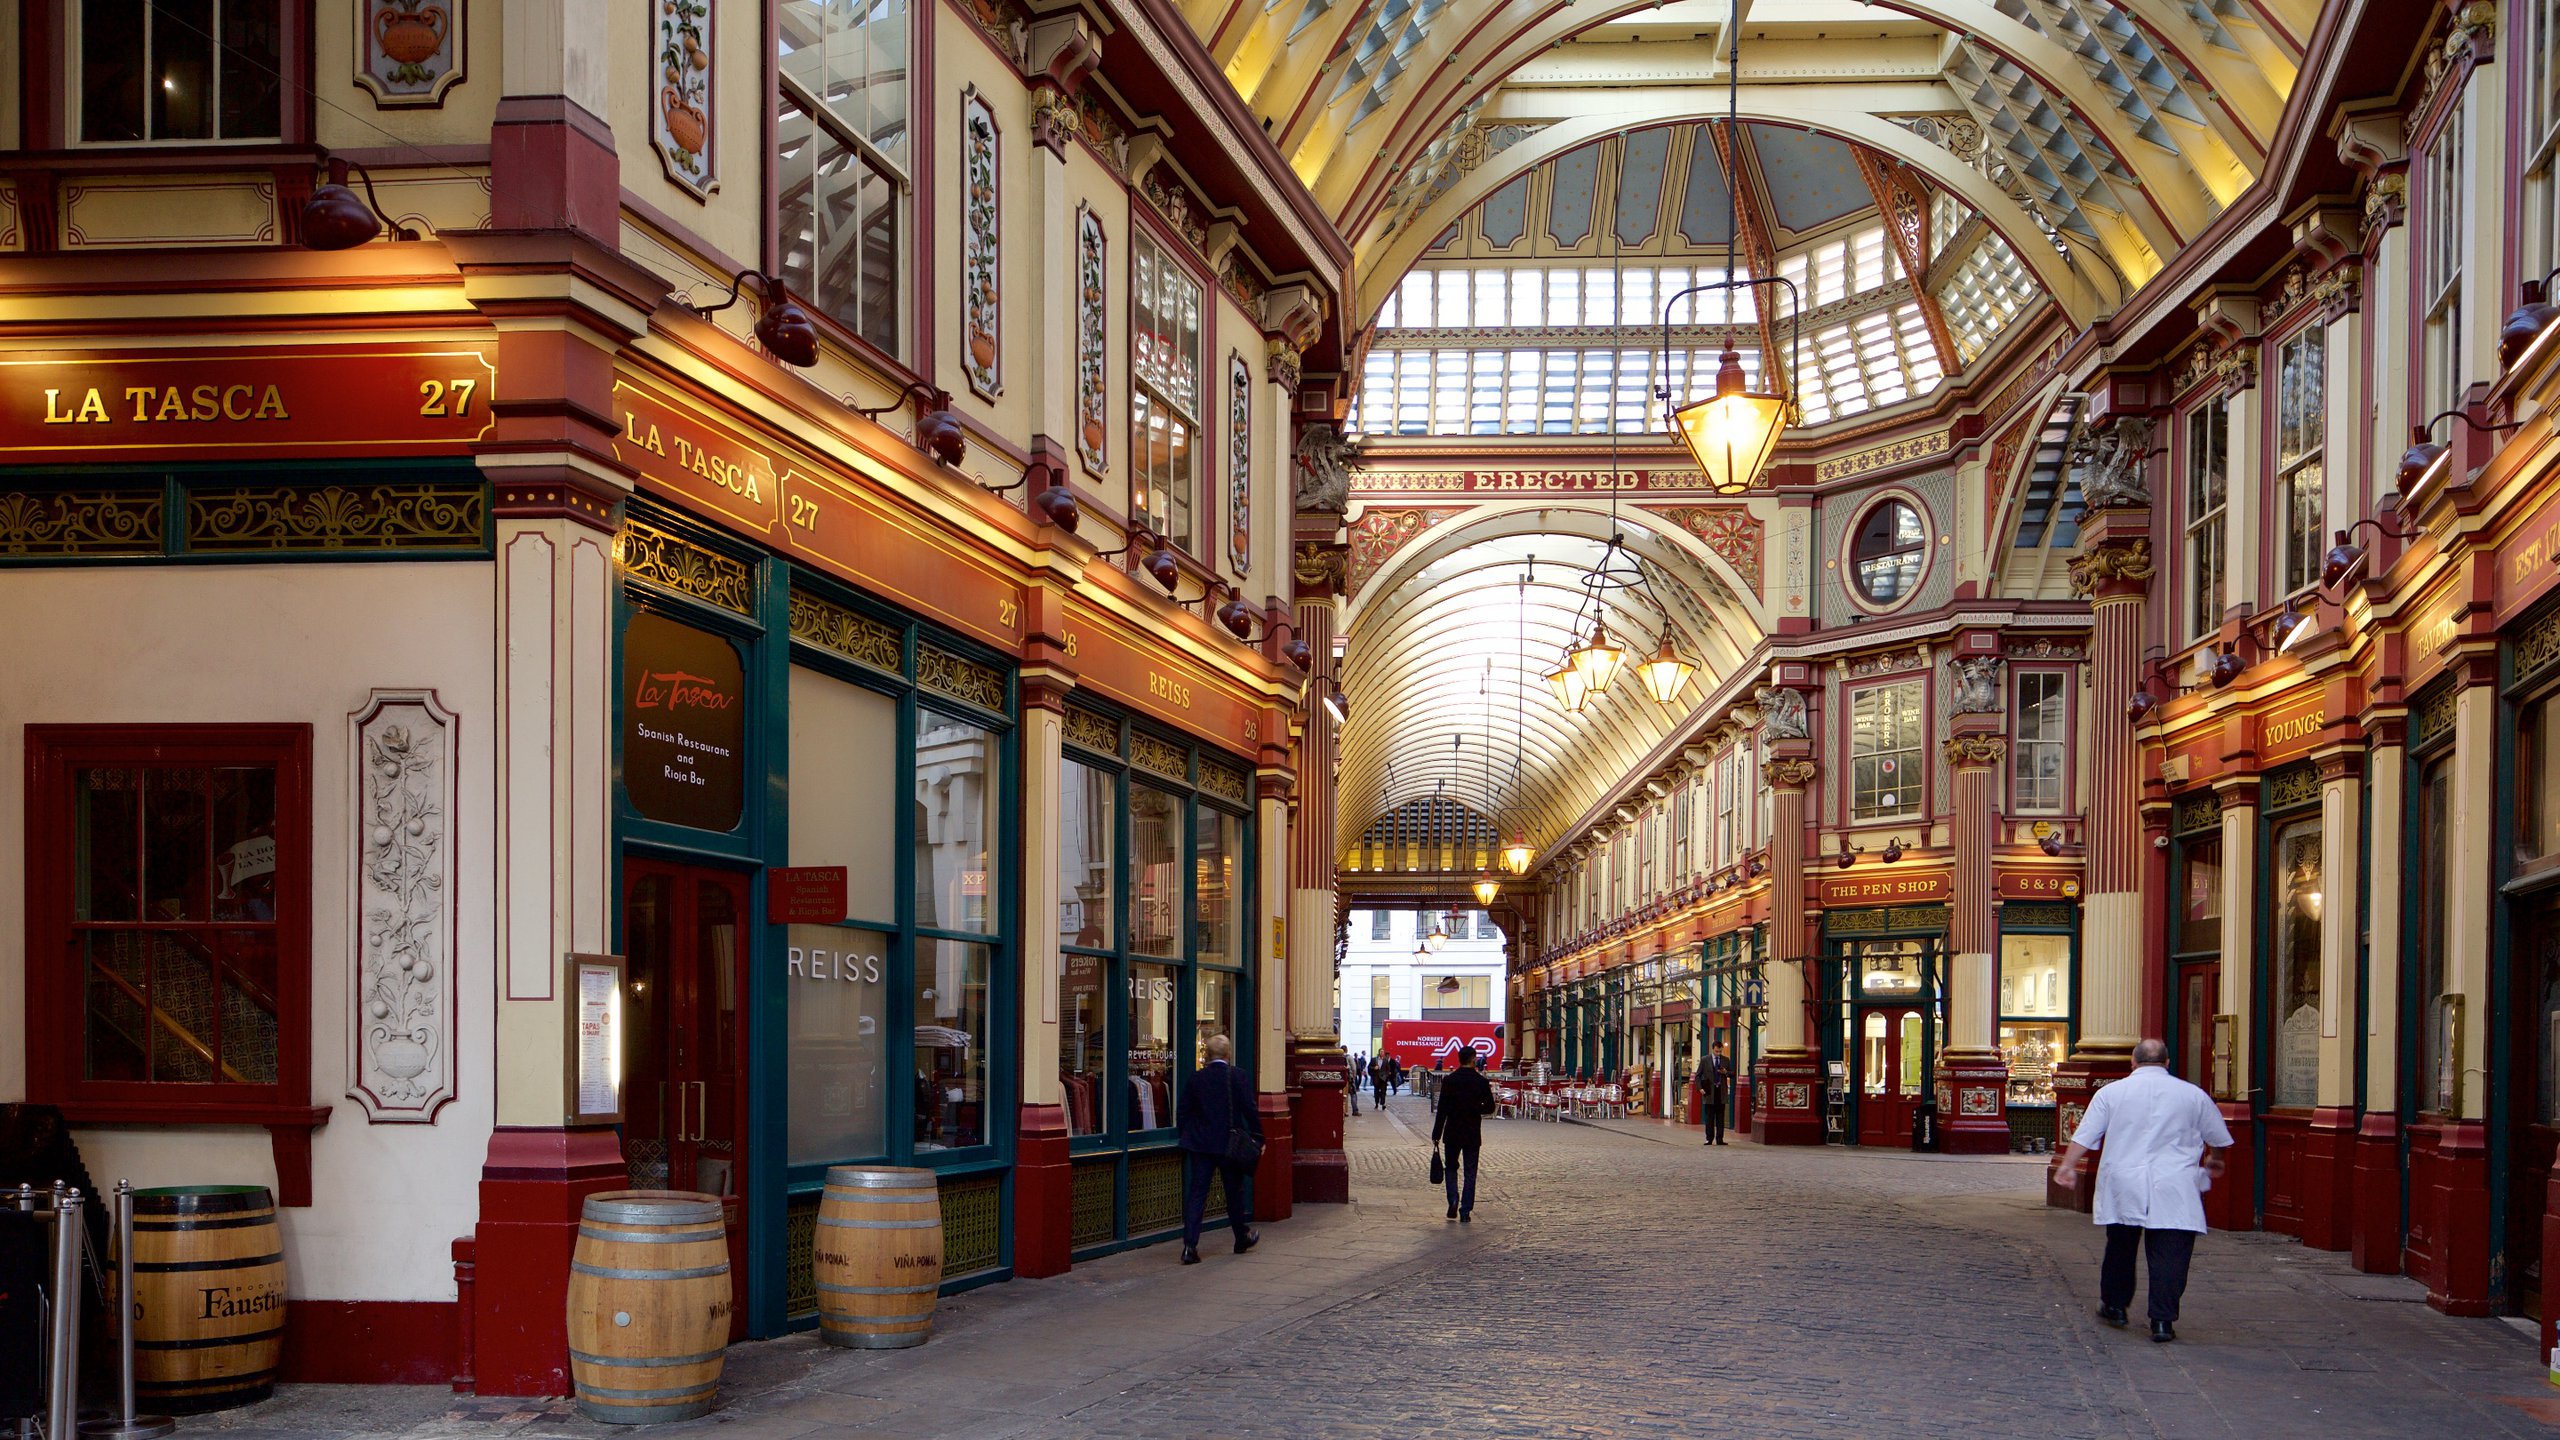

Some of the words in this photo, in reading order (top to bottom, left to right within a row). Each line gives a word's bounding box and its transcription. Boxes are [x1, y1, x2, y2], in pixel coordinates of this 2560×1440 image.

[44, 387, 111, 424] LA
[125, 384, 289, 422] TASCA
[419, 379, 478, 418] 27
[625, 411, 666, 457] LA
[674, 436, 762, 505] TASCA
[1473, 471, 1640, 491] ERECTED
[791, 494, 820, 532] 27
[1865, 555, 1920, 573] RESTAURANT
[2514, 537, 2543, 585] EST.
[999, 599, 1018, 629] 27
[636, 669, 667, 708] La
[651, 671, 733, 711] Tasca
[1149, 671, 1190, 709] REISS
[1245, 719, 1257, 742] 26
[1883, 690, 1891, 747] BROKERS
[2265, 710, 2326, 747] YOUNGS
[638, 723, 675, 744] Spanish
[677, 732, 730, 757] Restaurant
[677, 753, 694, 765] and
[664, 765, 688, 782] Rioja
[690, 771, 706, 786] Bar
[256, 845, 275, 855] BO
[256, 854, 275, 865] NA
[803, 871, 840, 882] TASCA
[1831, 885, 1858, 897] THE
[1862, 883, 1892, 896] PEN
[1897, 880, 1938, 893] SHOP
[2020, 878, 2029, 890] 8
[2033, 878, 2045, 890] &
[2049, 878, 2059, 890] 9
[788, 947, 880, 984] REISS
[893, 1254, 915, 1268] VIÑA
